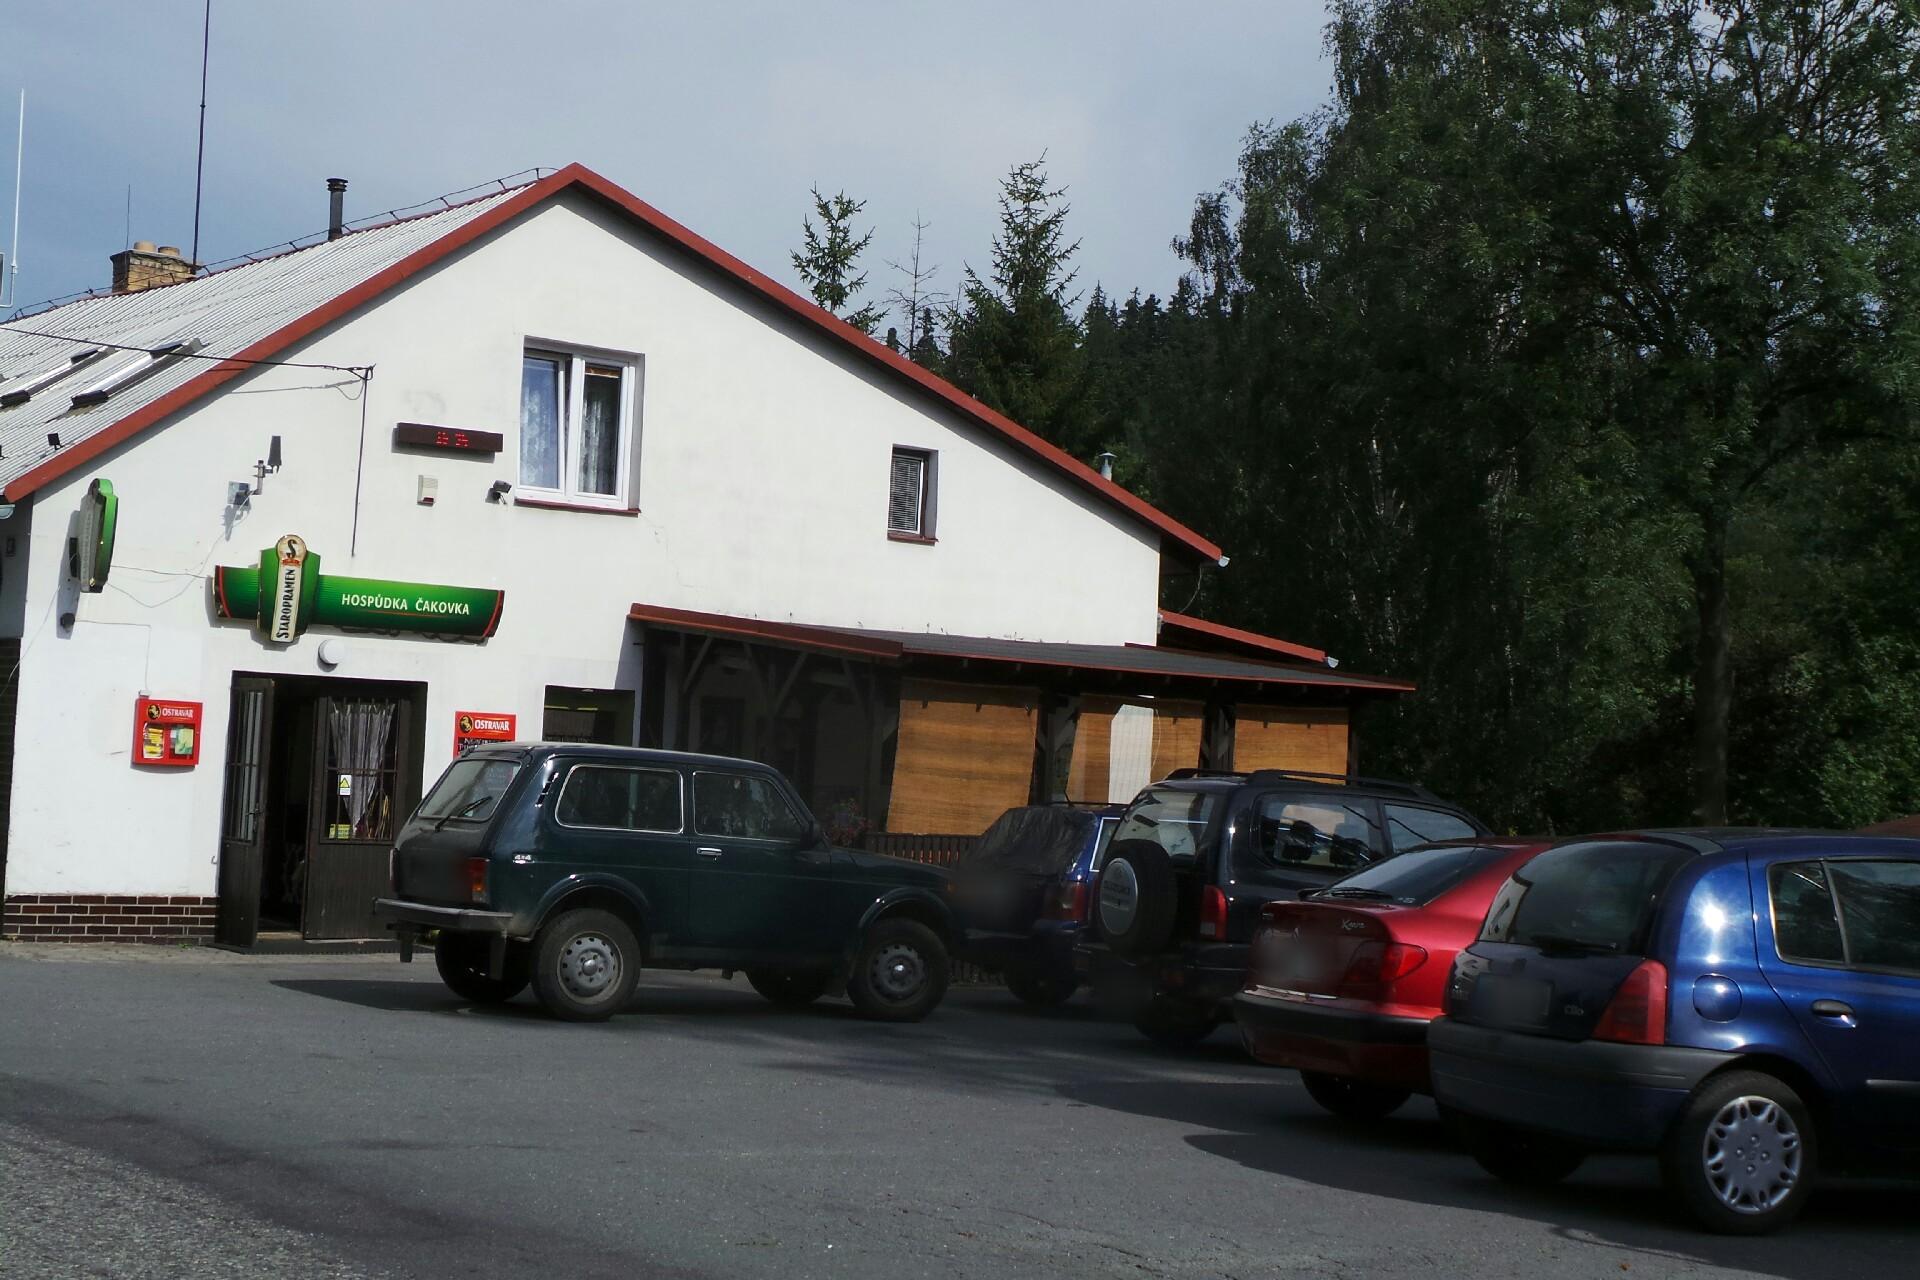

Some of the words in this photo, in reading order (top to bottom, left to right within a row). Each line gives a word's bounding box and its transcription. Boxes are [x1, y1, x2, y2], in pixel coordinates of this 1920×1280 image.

[275, 568, 296, 639] STAROPRAMEN
[415, 597, 470, 615] ČAKOVKA
[161, 707, 194, 718] OSTRAVAR
[474, 719, 510, 731] OSTRAVAR
